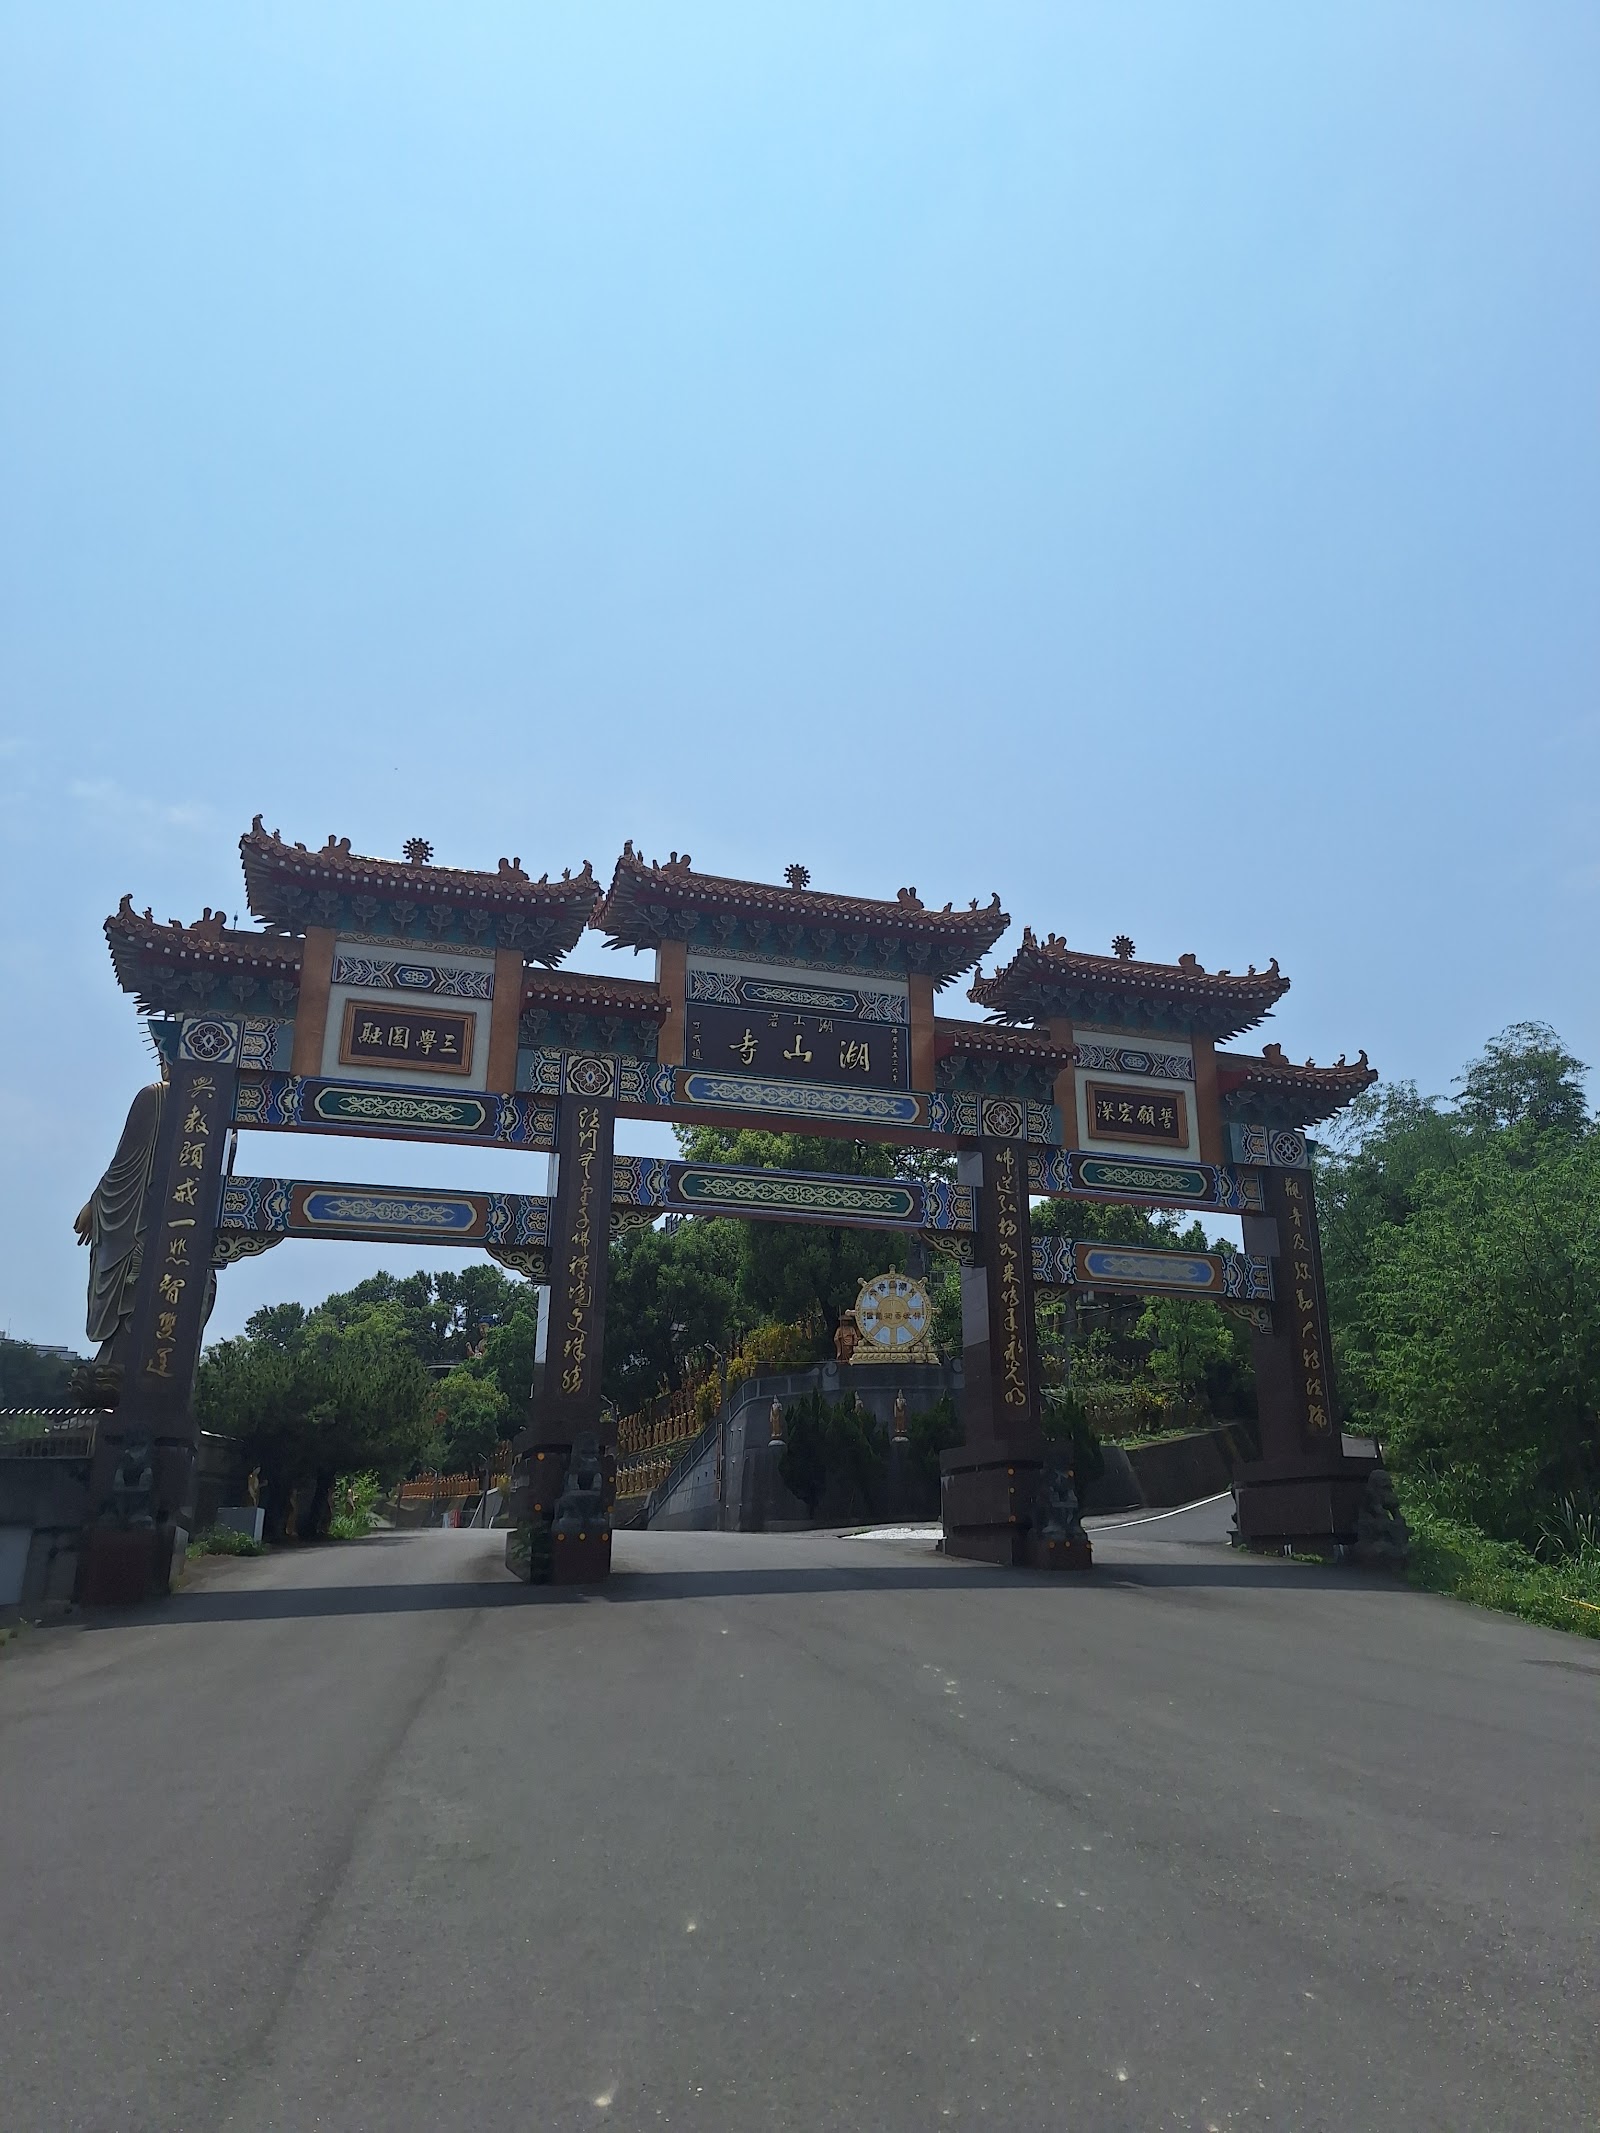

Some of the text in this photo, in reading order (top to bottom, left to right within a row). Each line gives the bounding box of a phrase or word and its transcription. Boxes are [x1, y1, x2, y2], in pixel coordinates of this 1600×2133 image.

[357, 1021, 458, 1056] 三學圓融
[729, 1028, 870, 1072] 湖山寺
[1096, 1100, 1175, 1130] 誓願宏深
